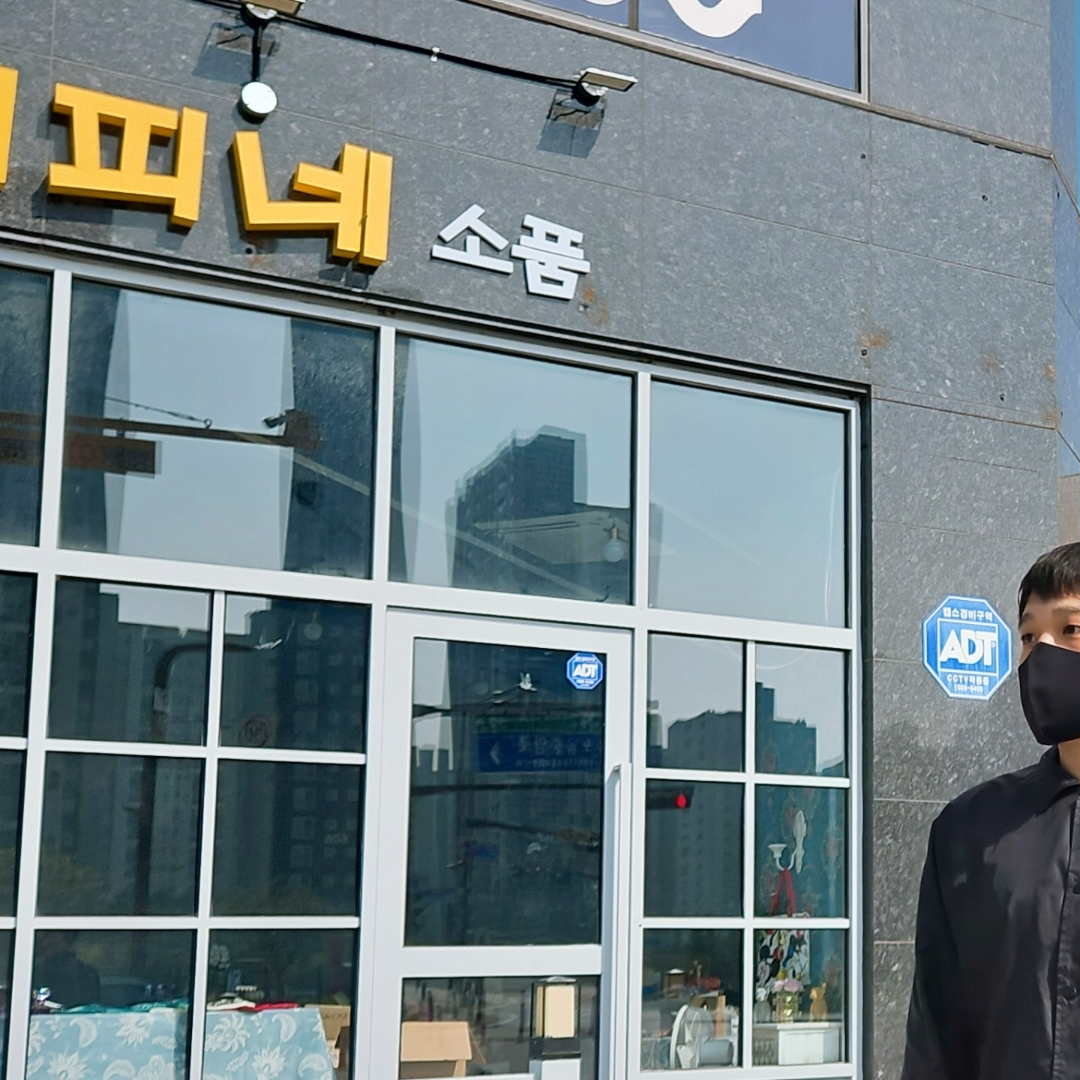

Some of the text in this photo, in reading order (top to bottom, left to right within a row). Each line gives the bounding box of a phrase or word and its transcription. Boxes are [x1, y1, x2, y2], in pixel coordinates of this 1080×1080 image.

[0, 66, 591, 300] 피네 소품
[940, 628, 998, 666] ADT
[572, 663, 598, 679] ADT
